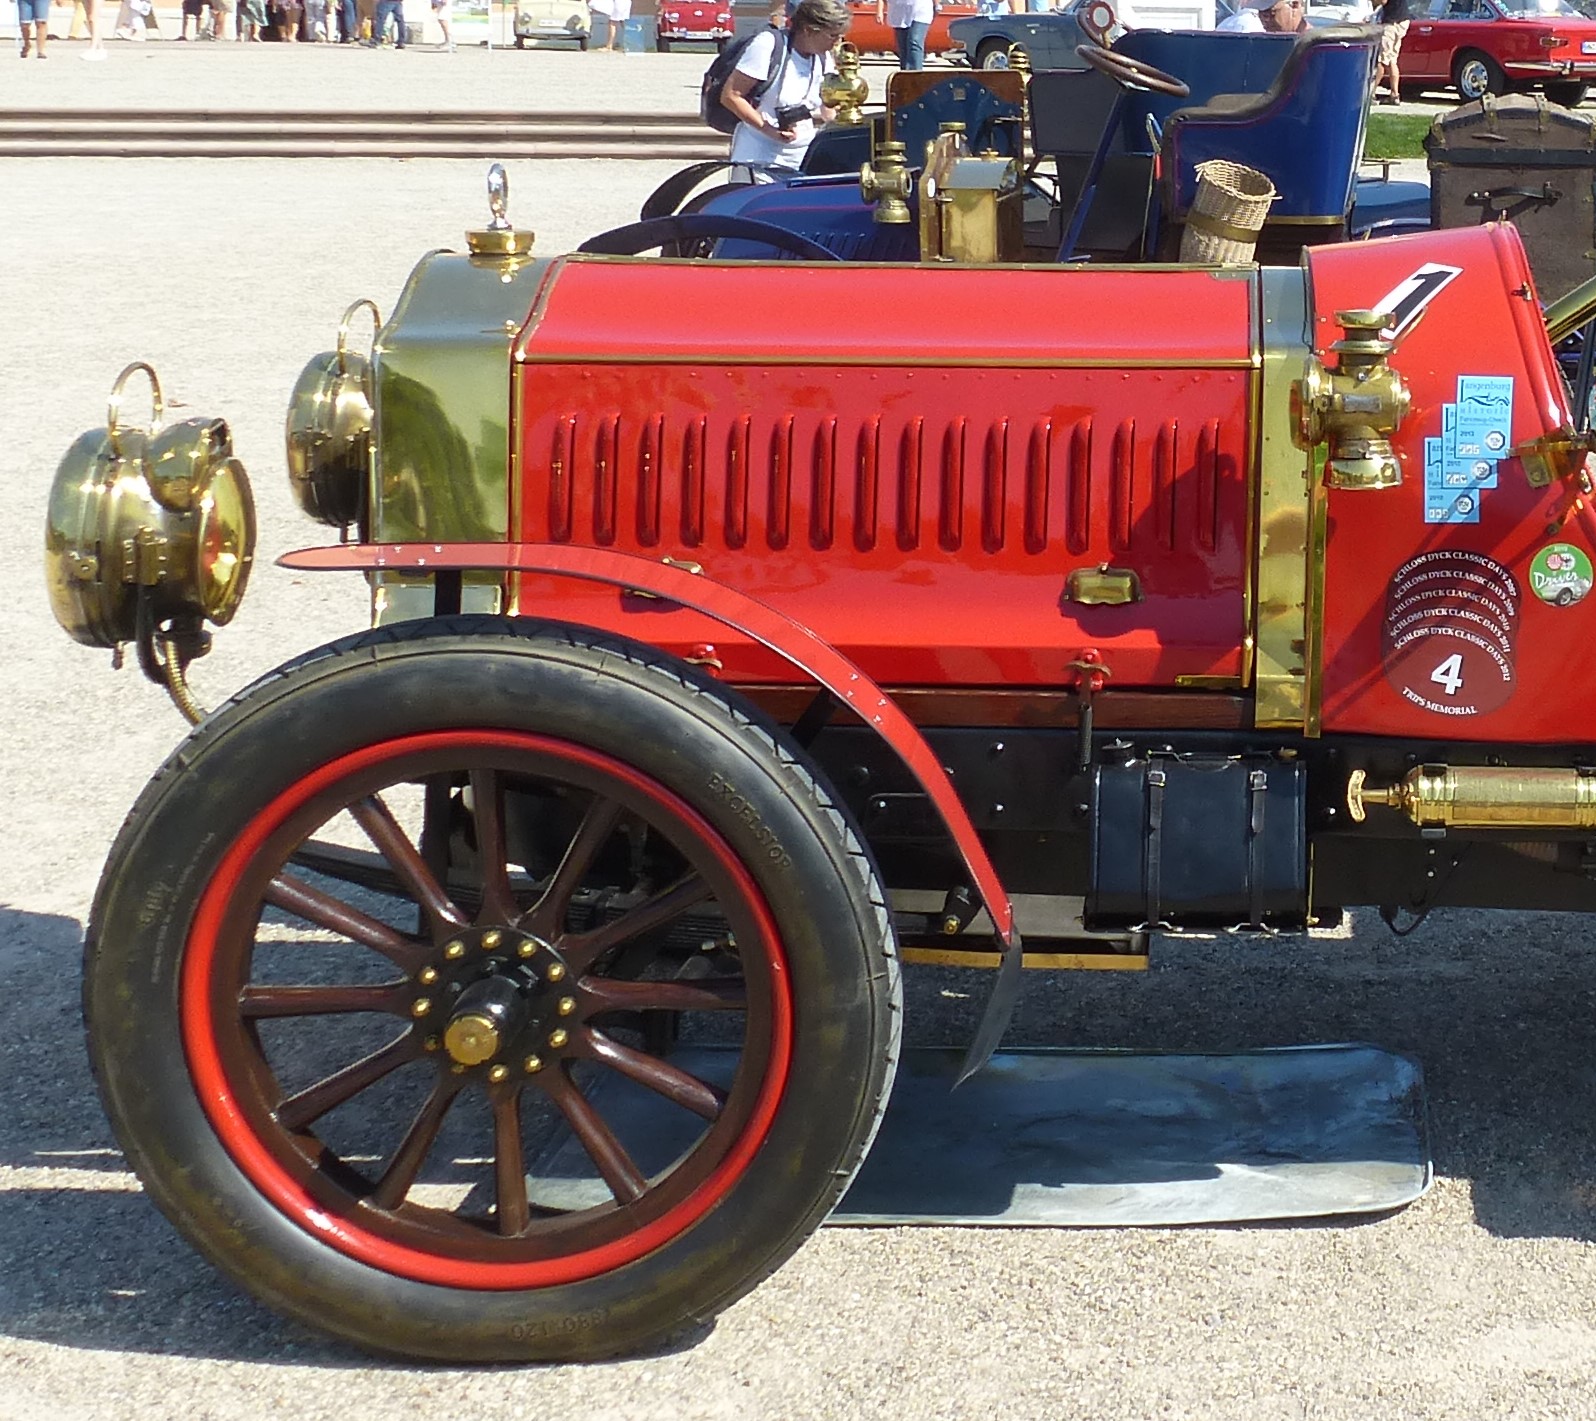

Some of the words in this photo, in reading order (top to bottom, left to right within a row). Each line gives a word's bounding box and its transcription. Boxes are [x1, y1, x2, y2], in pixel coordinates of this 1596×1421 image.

[1391, 271, 1453, 332] 1
[1394, 555, 1427, 583] SCHLOSS
[1427, 551, 1452, 562] DYCK
[1453, 551, 1488, 566] CLASSIC
[1487, 561, 1508, 580] DAYS
[1394, 573, 1428, 600] SCHLOSS
[1428, 570, 1453, 579] DYCK
[1453, 570, 1488, 586] CLASSIC
[1487, 581, 1506, 599] DAYS
[1388, 595, 1421, 622] SCHLOSS
[1421, 589, 1446, 599] DYCK
[1445, 588, 1482, 602] CLASSIC
[1481, 597, 1501, 615] DAYS
[1390, 610, 1423, 637] SCHLOSS
[1423, 608, 1448, 618] DYCK
[1448, 608, 1482, 624] CLASSIC
[1482, 619, 1502, 637] DAYS
[1394, 627, 1430, 650] SCHLOSS
[1430, 627, 1455, 635] DYCK
[1454, 629, 1488, 650] CLASSIC
[1485, 645, 1505, 665] DAYS
[1431, 653, 1463, 695] 4
[1426, 701, 1478, 715] MEMORIAL
